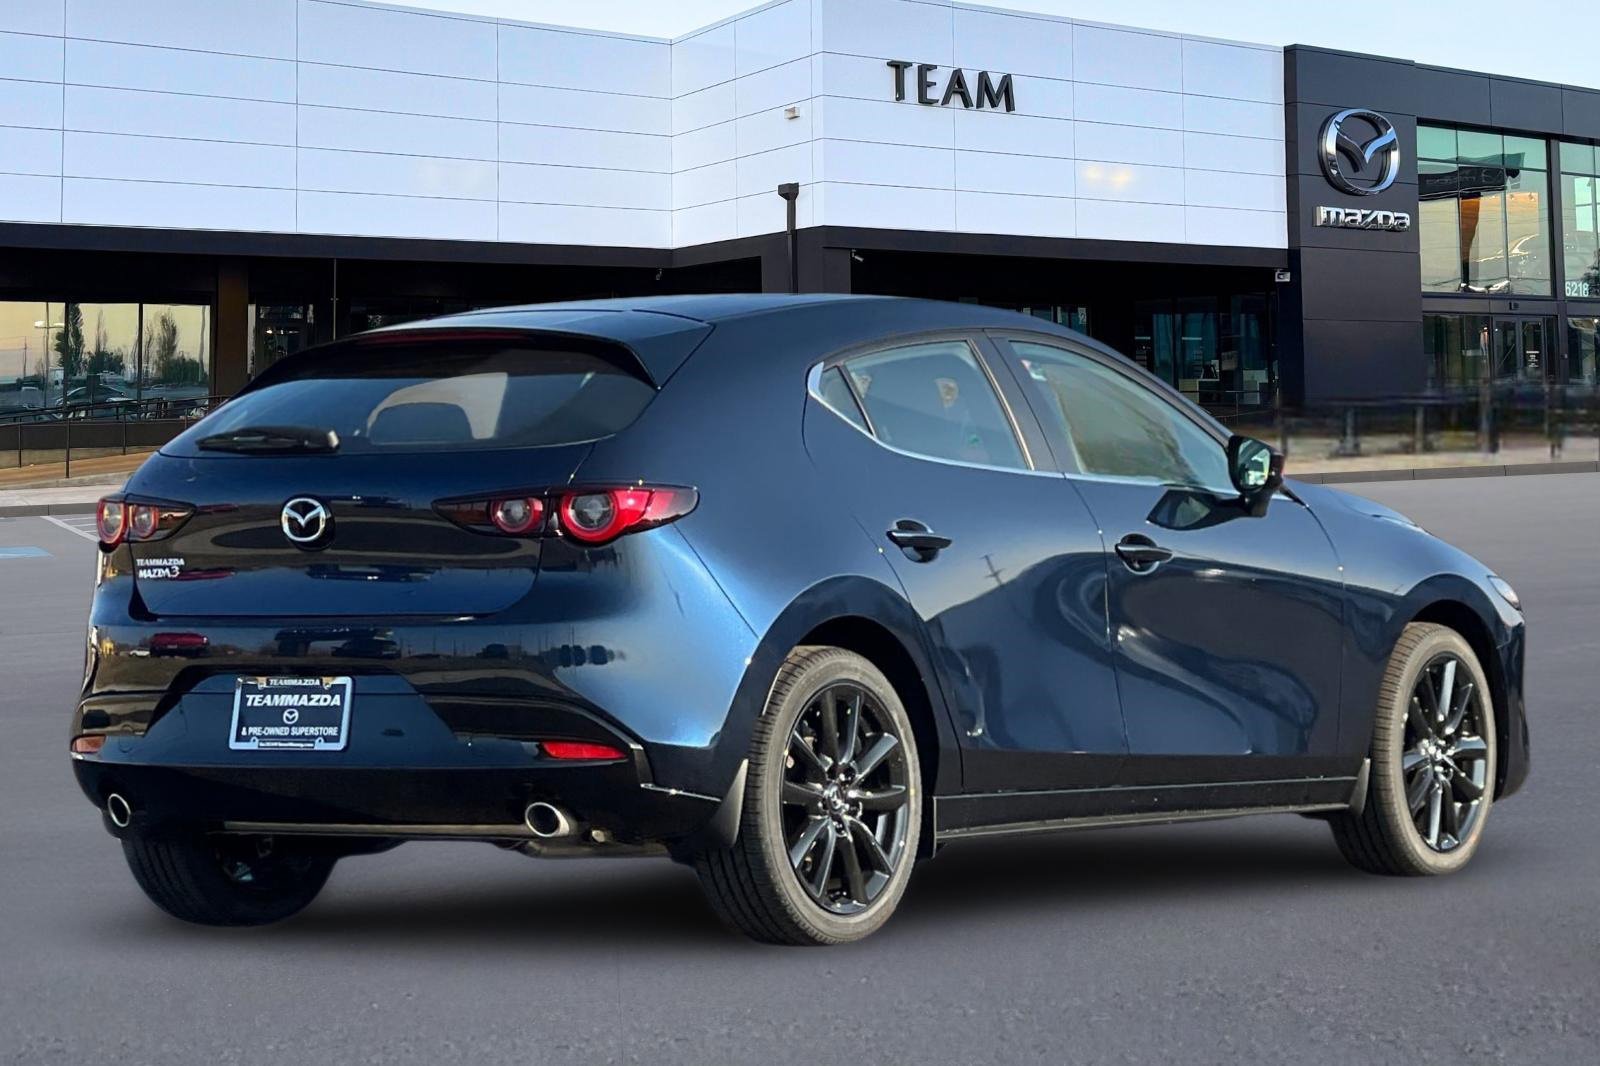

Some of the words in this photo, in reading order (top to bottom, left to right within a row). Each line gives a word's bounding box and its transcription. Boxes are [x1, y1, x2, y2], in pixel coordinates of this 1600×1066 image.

[887, 60, 1016, 112] TEAM
[1565, 281, 1590, 297] 6218
[246, 694, 341, 706] TEAMMAZDA
[248, 727, 290, 736] PRE-OWNED
[290, 727, 339, 736] SUPERSTORE
